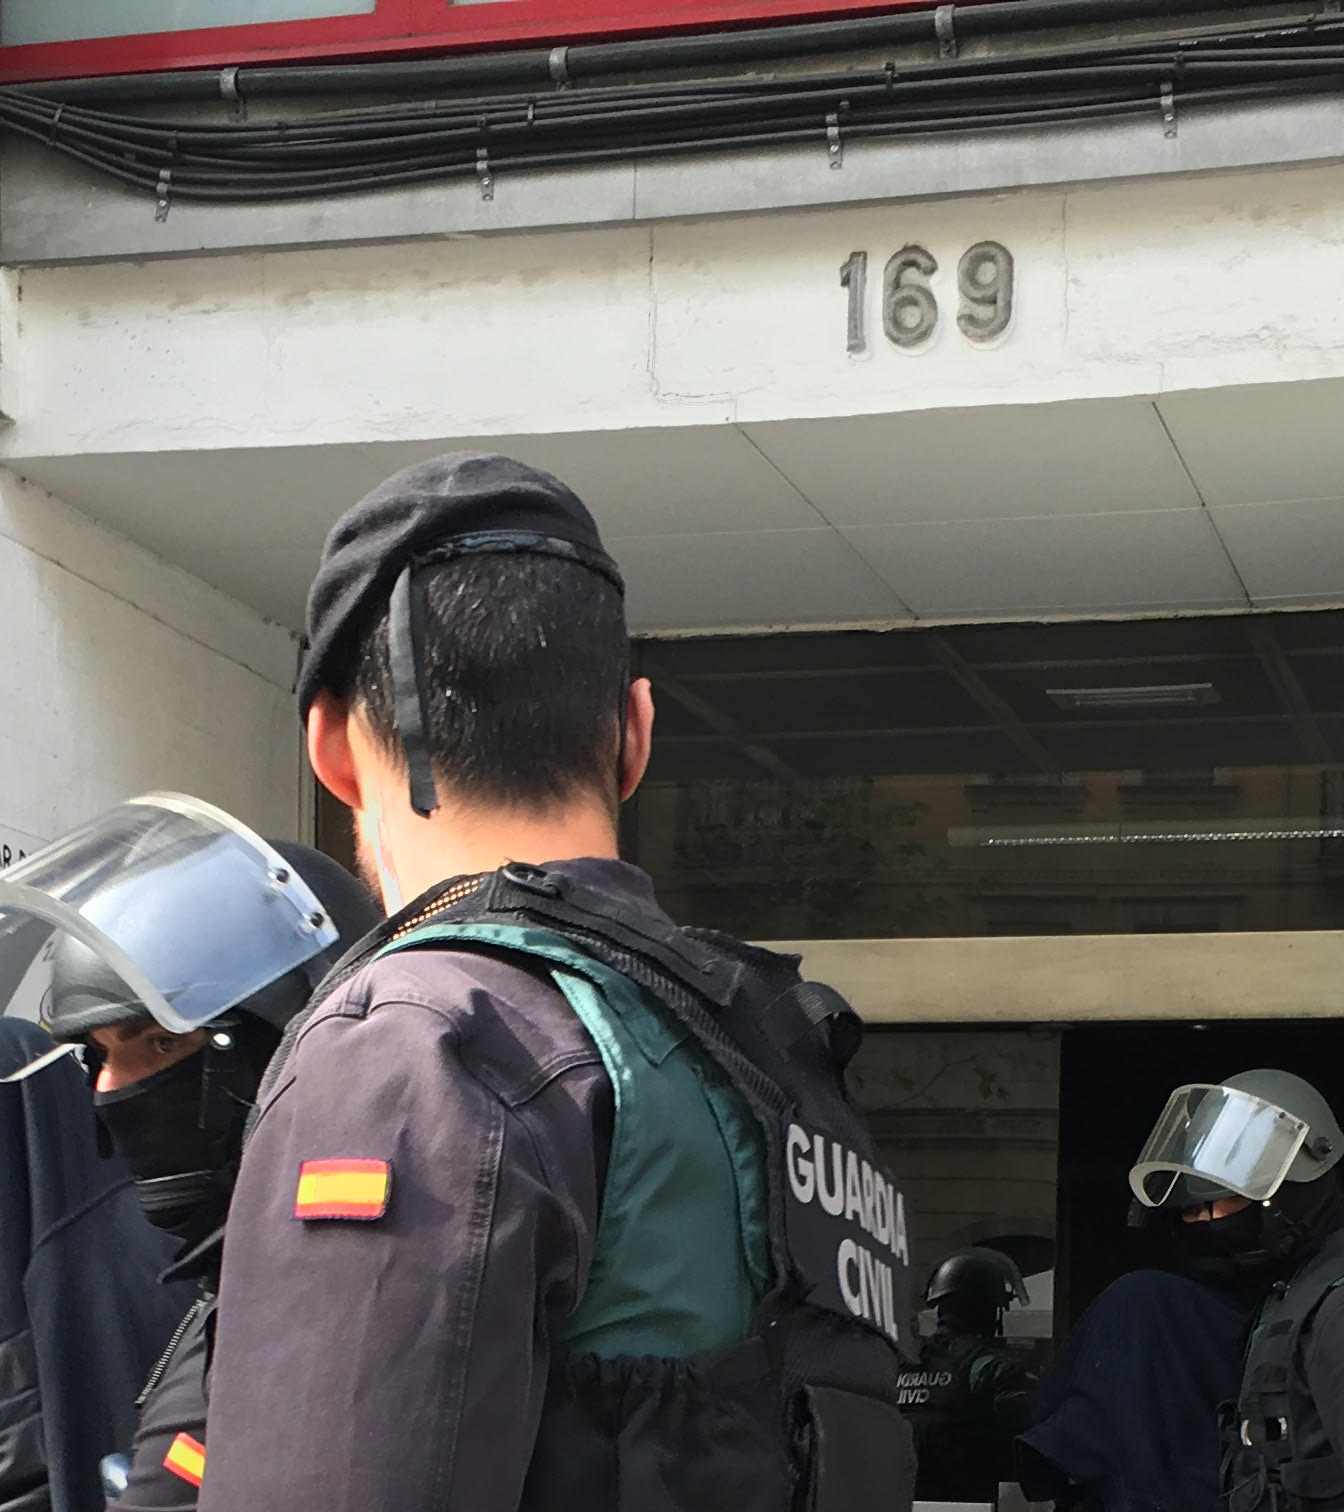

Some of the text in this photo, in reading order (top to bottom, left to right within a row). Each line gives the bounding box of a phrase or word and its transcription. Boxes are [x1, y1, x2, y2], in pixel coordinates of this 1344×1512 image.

[840, 240, 1014, 352] 169
[786, 1123, 909, 1267] GUARDIA
[837, 1238, 899, 1342] CIVIL
